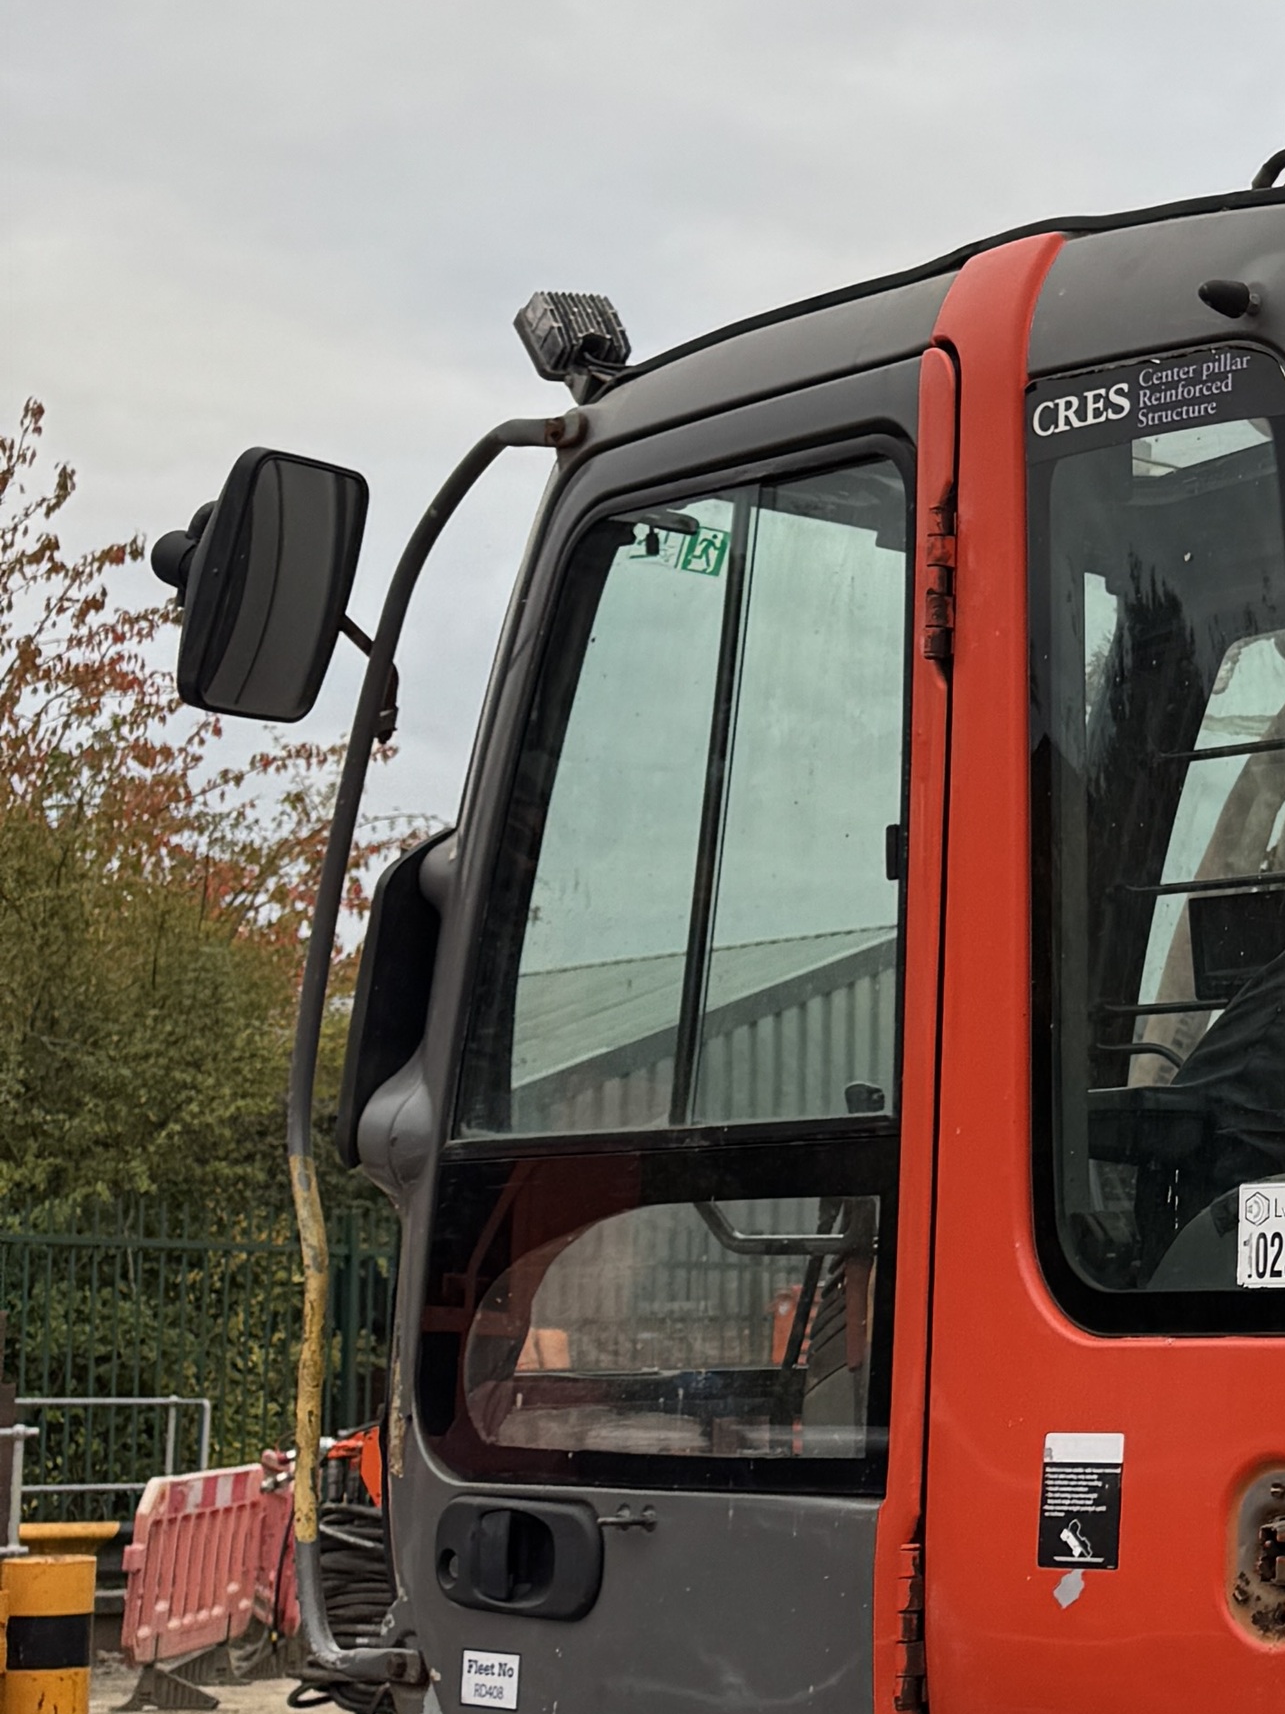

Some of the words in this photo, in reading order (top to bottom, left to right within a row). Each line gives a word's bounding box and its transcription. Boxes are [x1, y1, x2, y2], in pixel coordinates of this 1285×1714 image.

[1138, 365, 1197, 388] Center
[1202, 352, 1251, 381] pillar
[1138, 373, 1233, 407] Reinforced
[1032, 382, 1131, 437] CRES
[1137, 400, 1217, 428] Structure
[1243, 1231, 1284, 1279] 102
[467, 1658, 495, 1676] Fleet
[497, 1662, 514, 1678] No
